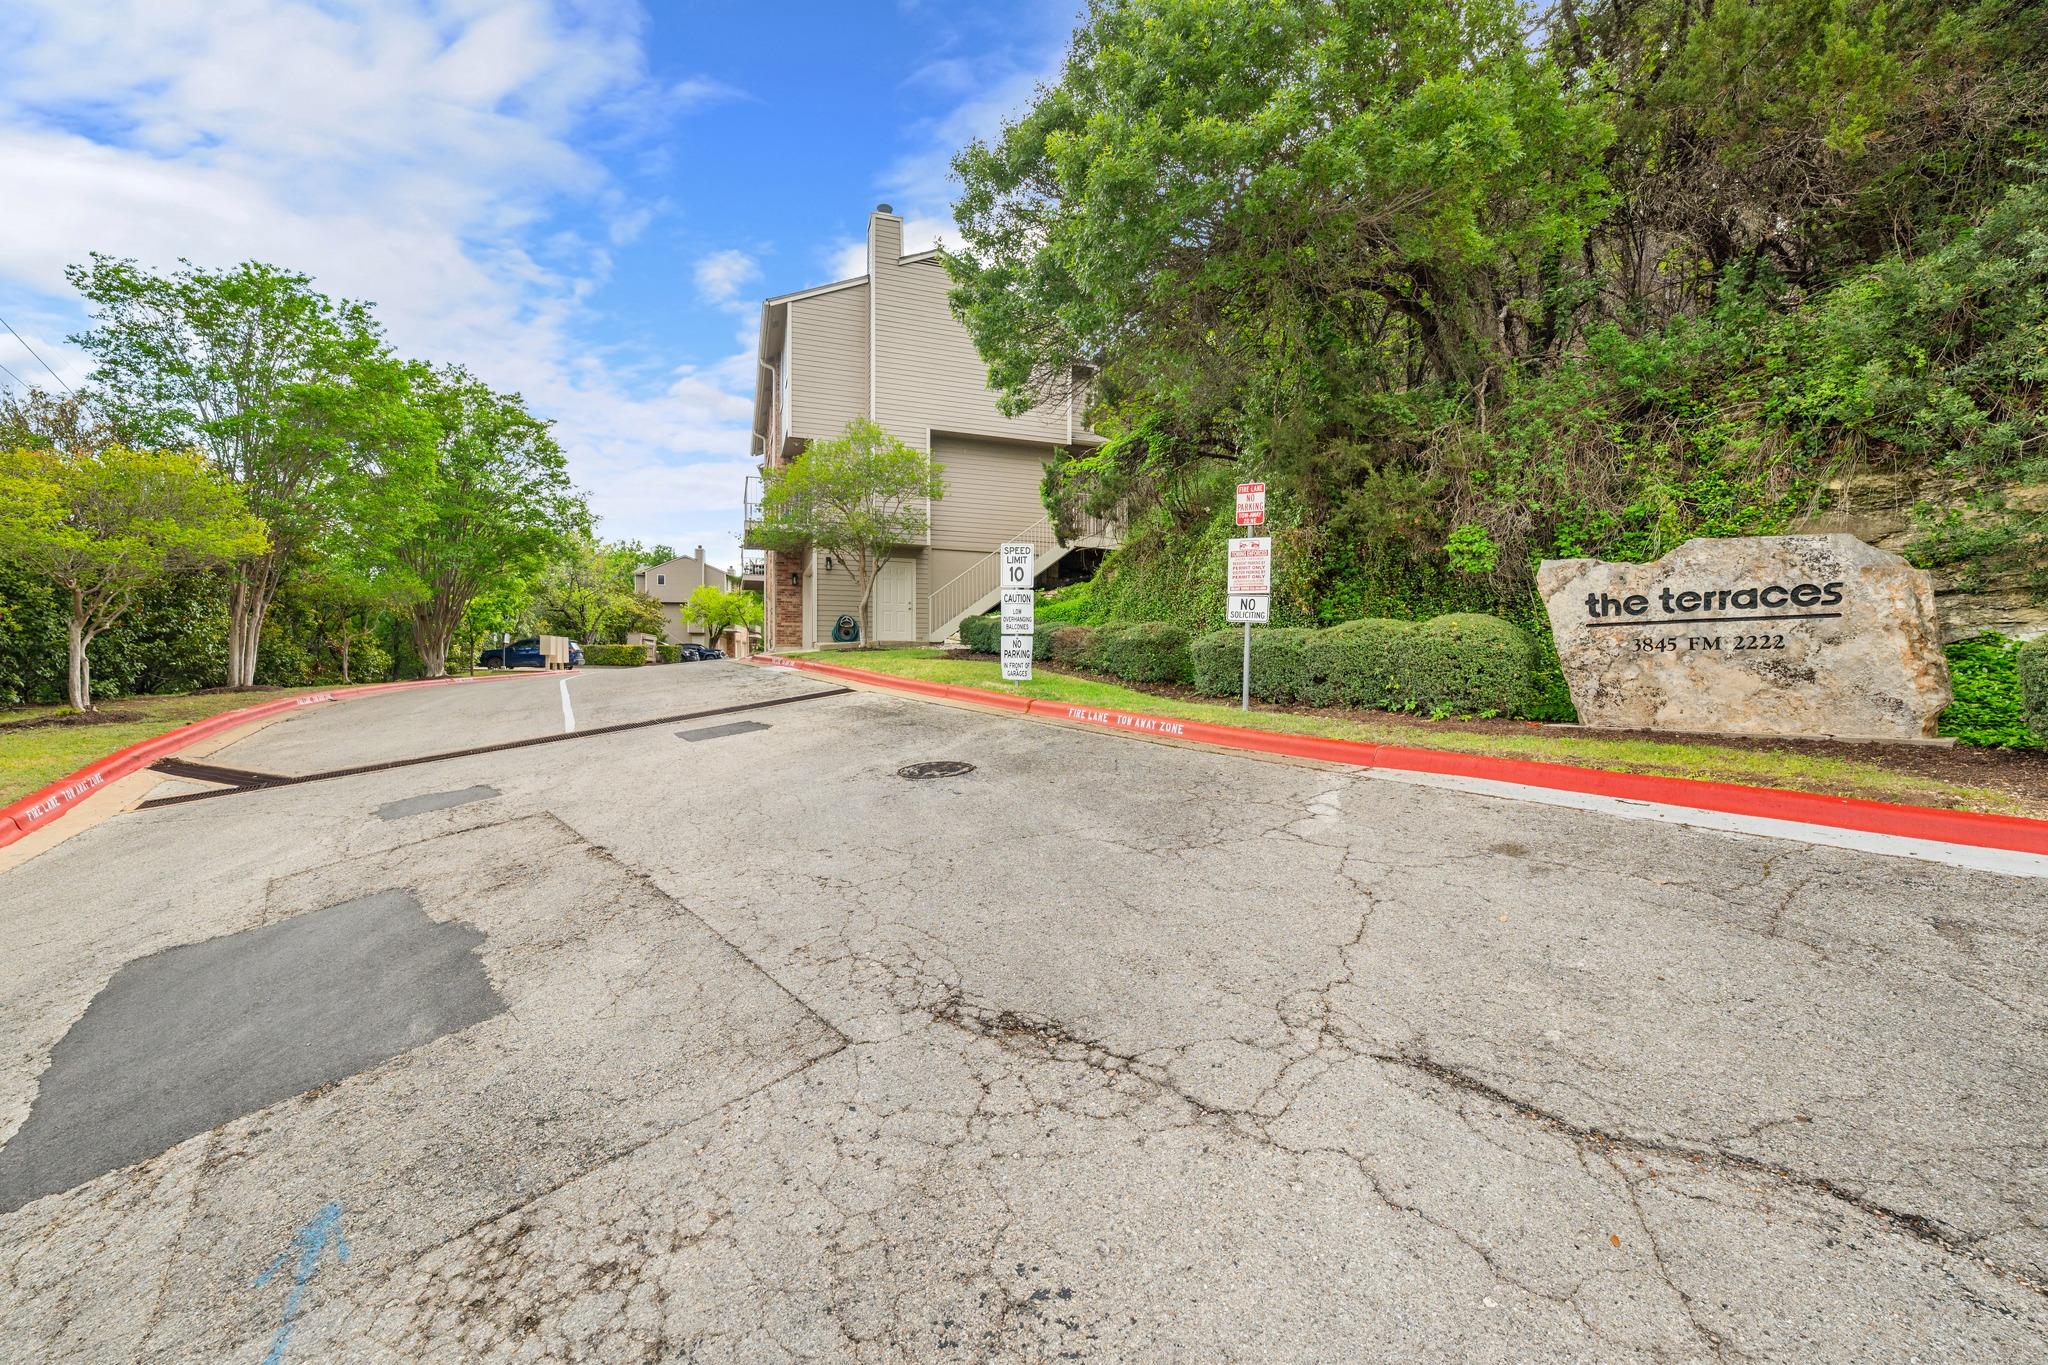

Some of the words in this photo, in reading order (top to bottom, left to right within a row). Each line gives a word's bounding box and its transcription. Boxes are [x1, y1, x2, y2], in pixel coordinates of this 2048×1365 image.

[1238, 502, 1263, 511] PARKING
[1004, 547, 1030, 555] SPEED
[1007, 556, 1027, 564] LIMIT
[1010, 567, 1024, 582] 10
[1004, 594, 1031, 603] CAUTION
[1584, 592, 1649, 618] the
[1658, 581, 1844, 614] terraces
[1240, 598, 1256, 610] NO
[1230, 611, 1265, 619] SOLICITING
[1012, 640, 1022, 649] NO
[1632, 637, 1678, 654] 3845
[1689, 636, 1722, 651] FM
[1733, 635, 1786, 651] 2222
[1004, 650, 1030, 658] PARKING
[1068, 708, 1086, 720] FIRE
[1088, 711, 1109, 723] LANE
[1116, 714, 1133, 726] TOW
[1135, 717, 1156, 730] AWAY
[1159, 721, 1184, 735] ZONE
[25, 805, 43, 822] FIRE
[42, 795, 61, 812] LANE
[88, 772, 104, 787] ZONE
